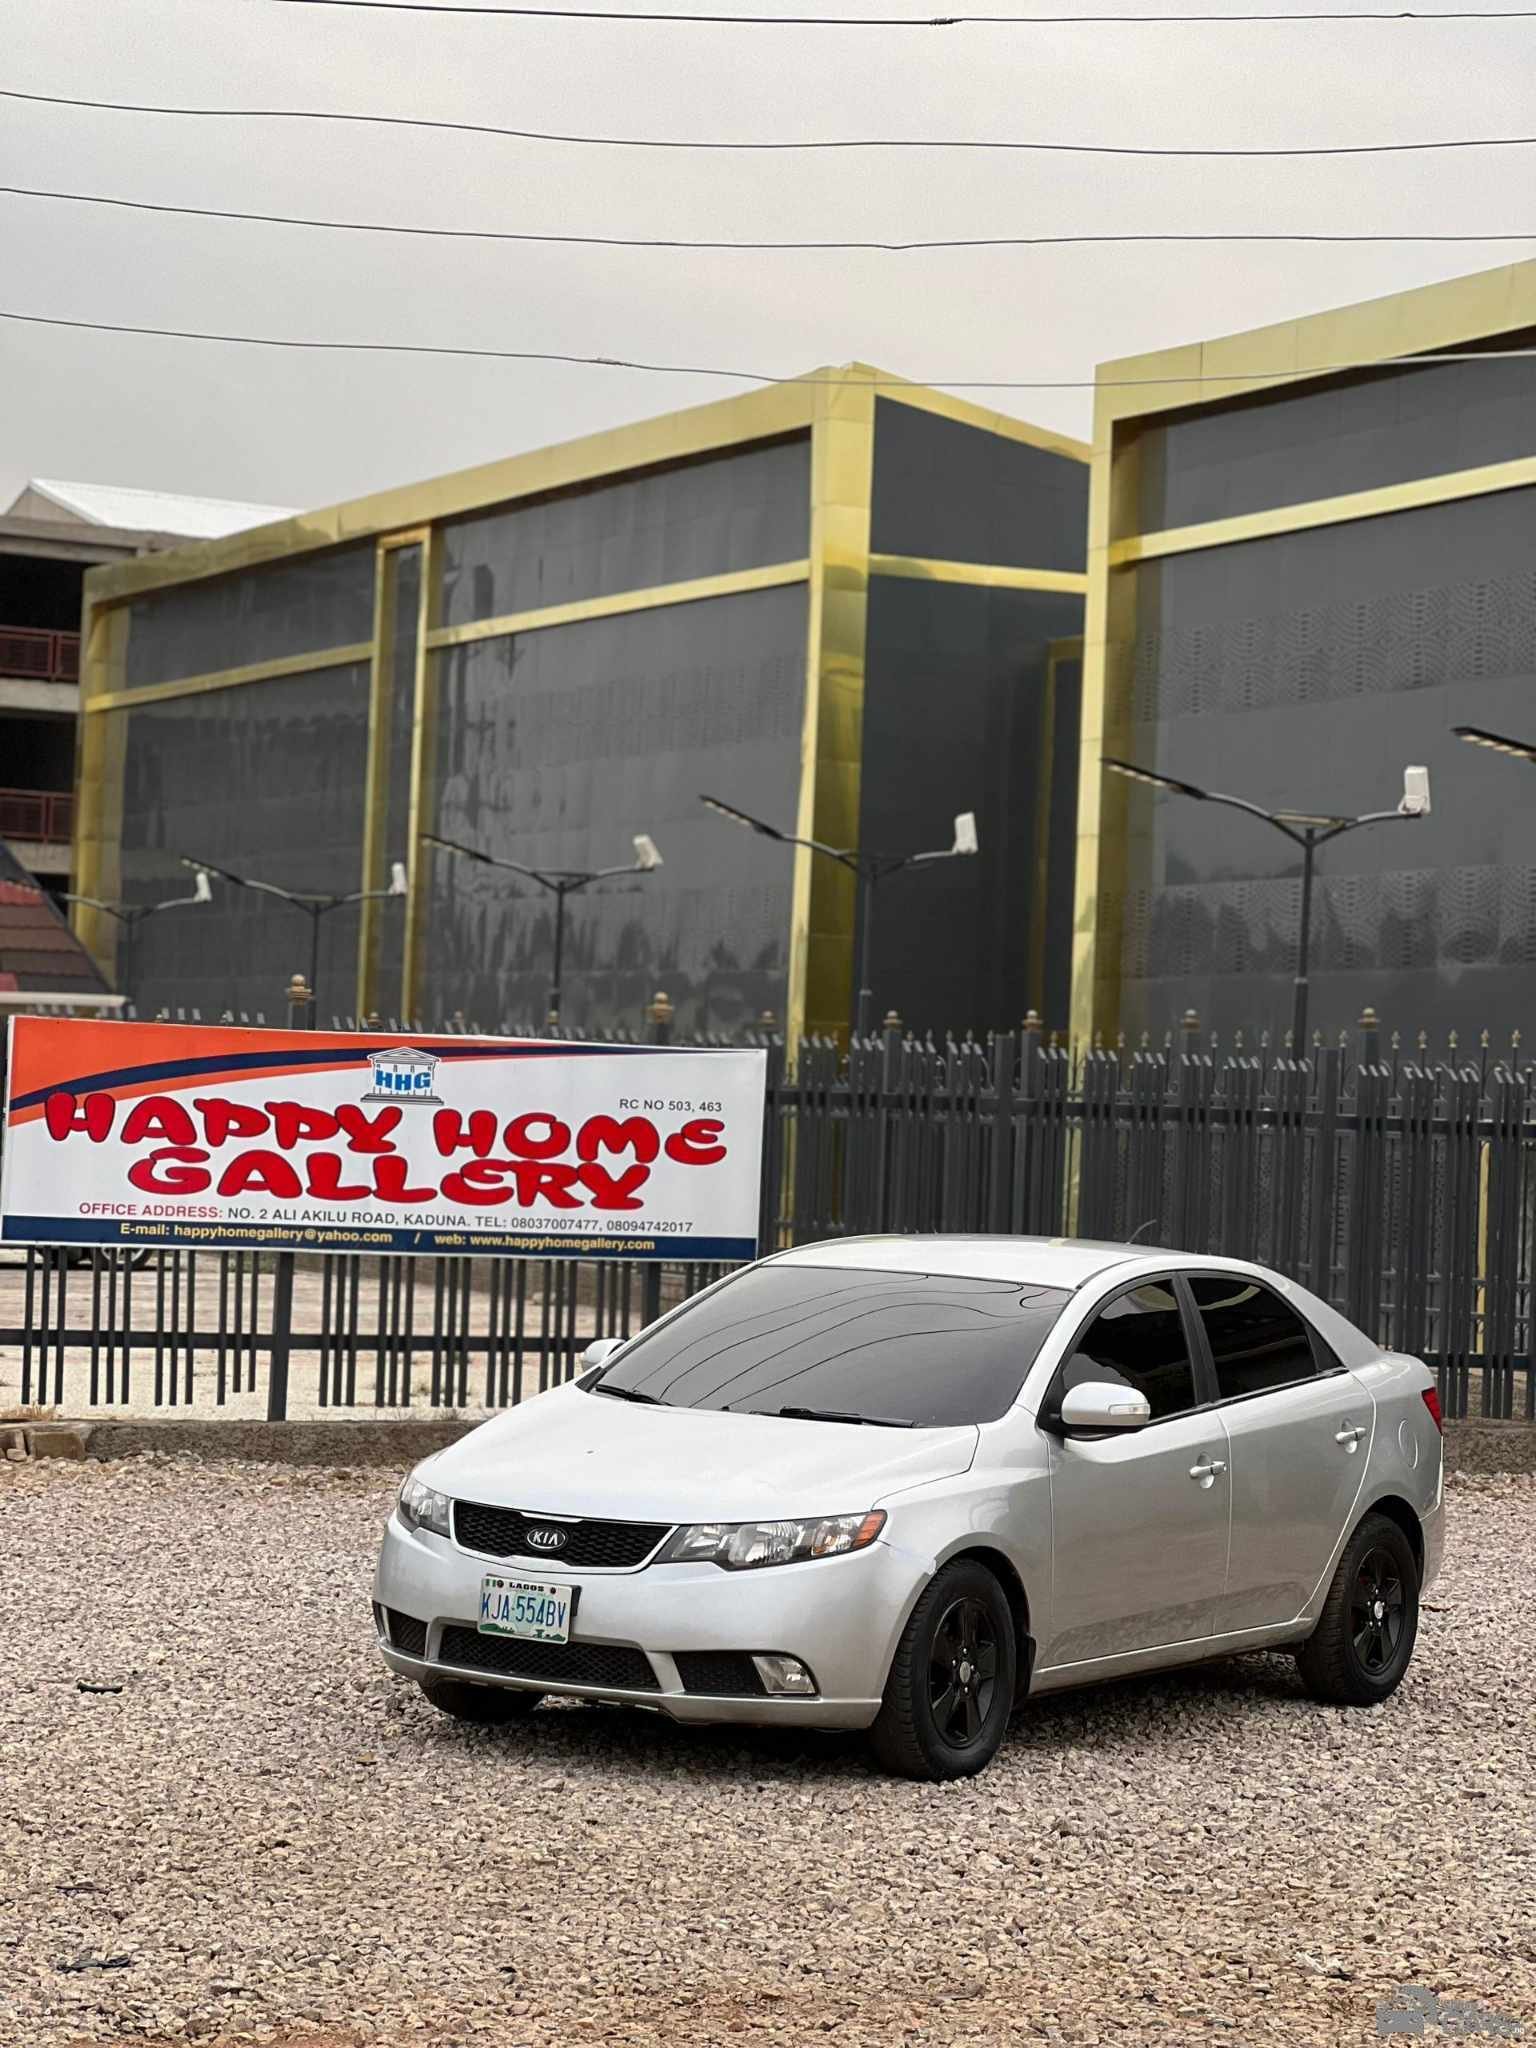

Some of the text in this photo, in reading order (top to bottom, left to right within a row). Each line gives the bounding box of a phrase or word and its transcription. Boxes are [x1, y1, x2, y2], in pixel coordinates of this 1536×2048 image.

[375, 1069, 431, 1091] HHG
[619, 1098, 722, 1113] RC NO 503, 463
[45, 1092, 727, 1166] HAPPY HOME
[128, 1147, 650, 1210] GALLERY
[79, 1202, 137, 1216] OFFICE
[142, 1204, 223, 1218] ADDRESS:
[228, 1207, 255, 1219] NO.
[259, 1208, 268, 1220] 2
[272, 1209, 297, 1221] ALI
[301, 1210, 347, 1223] AKILU
[351, 1212, 399, 1226] ROAD,
[404, 1213, 470, 1227] KADUNA.
[475, 1216, 507, 1229] TEL:
[606, 1220, 693, 1233] 08094742017
[120, 1222, 170, 1236] E-mail:
[174, 1224, 393, 1243] happyhomegallery@yahoo.com
[434, 1233, 467, 1246] web:
[470, 1234, 656, 1252] www.happyhomegallery.com
[532, 1531, 558, 1546] KIA
[509, 1582, 545, 1592] LAGOS
